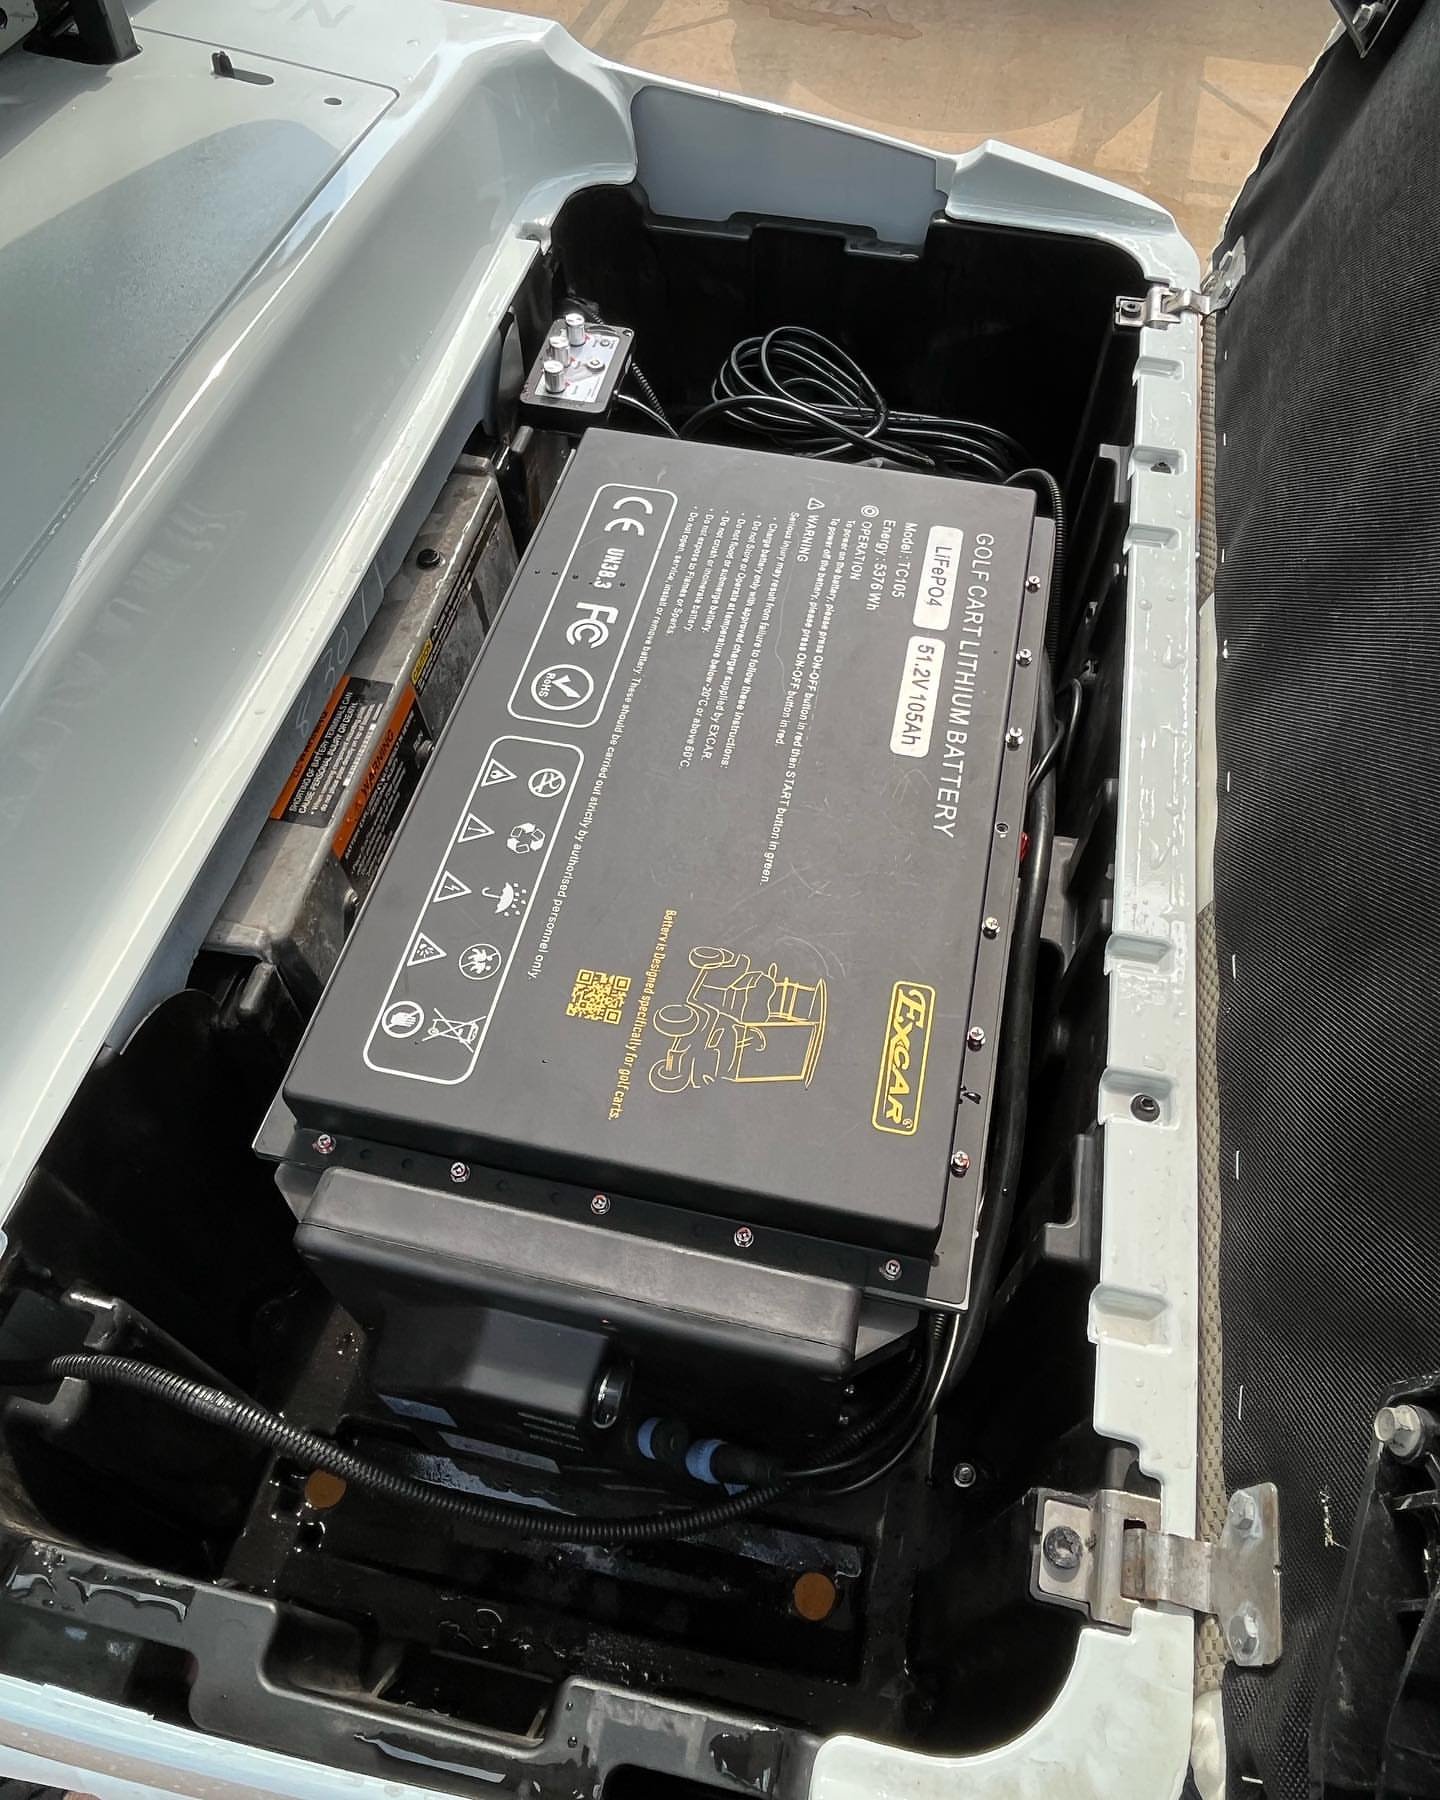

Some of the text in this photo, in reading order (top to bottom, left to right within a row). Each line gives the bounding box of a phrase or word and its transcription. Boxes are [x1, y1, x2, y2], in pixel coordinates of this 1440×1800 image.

[603, 495, 655, 536] CE
[686, 511, 698, 522] Do
[702, 514, 713, 524] Do
[718, 516, 729, 526] Do
[734, 518, 745, 529] Do
[750, 520, 762, 531] Do
[782, 511, 800, 539] Serious
[829, 517, 840, 526] To
[845, 519, 855, 528] To
[795, 514, 820, 562] WARNING
[848, 520, 873, 580] OPERATION
[591, 546, 626, 590] UN38.3
[738, 563, 748, 572] or
[770, 561, 785, 579] may
[869, 562, 887, 590] 5376
[890, 560, 910, 598] TC105
[924, 545, 951, 607] LiFePO4
[765, 578, 781, 601] result
[865, 591, 882, 611] Wh
[760, 601, 774, 621] from
[752, 621, 769, 647] failure
[750, 649, 761, 657] to
[742, 658, 759, 684] follow
[787, 652, 807, 689] ON-OFF
[804, 654, 824, 692] ON-OFF
[537, 672, 556, 697] RoHS
[623, 676, 642, 703] These
[712, 675, 734, 711] supplied
[734, 685, 751, 710] these
[900, 644, 935, 746] 51.2V 105Ah
[929, 532, 995, 838] GOLF CART LITHIUM BATTERY
[694, 707, 704, 716] or
[709, 711, 723, 723] by
[781, 690, 797, 718] button
[798, 692, 814, 721] button
[613, 704, 632, 733] should
[685, 718, 702, 745] above
[608, 734, 621, 745] be
[699, 723, 720, 762] EXCAR.
[773, 728, 788, 747] red.
[792, 731, 805, 746] red
[597, 746, 617, 779] carried
[591, 779, 604, 795] out
[777, 770, 796, 806] START
[579, 795, 600, 829] strictly
[769, 807, 787, 839] button
[573, 829, 588, 842] by
[756, 851, 775, 886] green.
[535, 898, 565, 953] personnel
[639, 951, 665, 995] Designed
[623, 994, 654, 1052] specifically
[621, 1051, 637, 1068] for
[613, 1067, 633, 1091] golf
[606, 1089, 626, 1122] carts.
